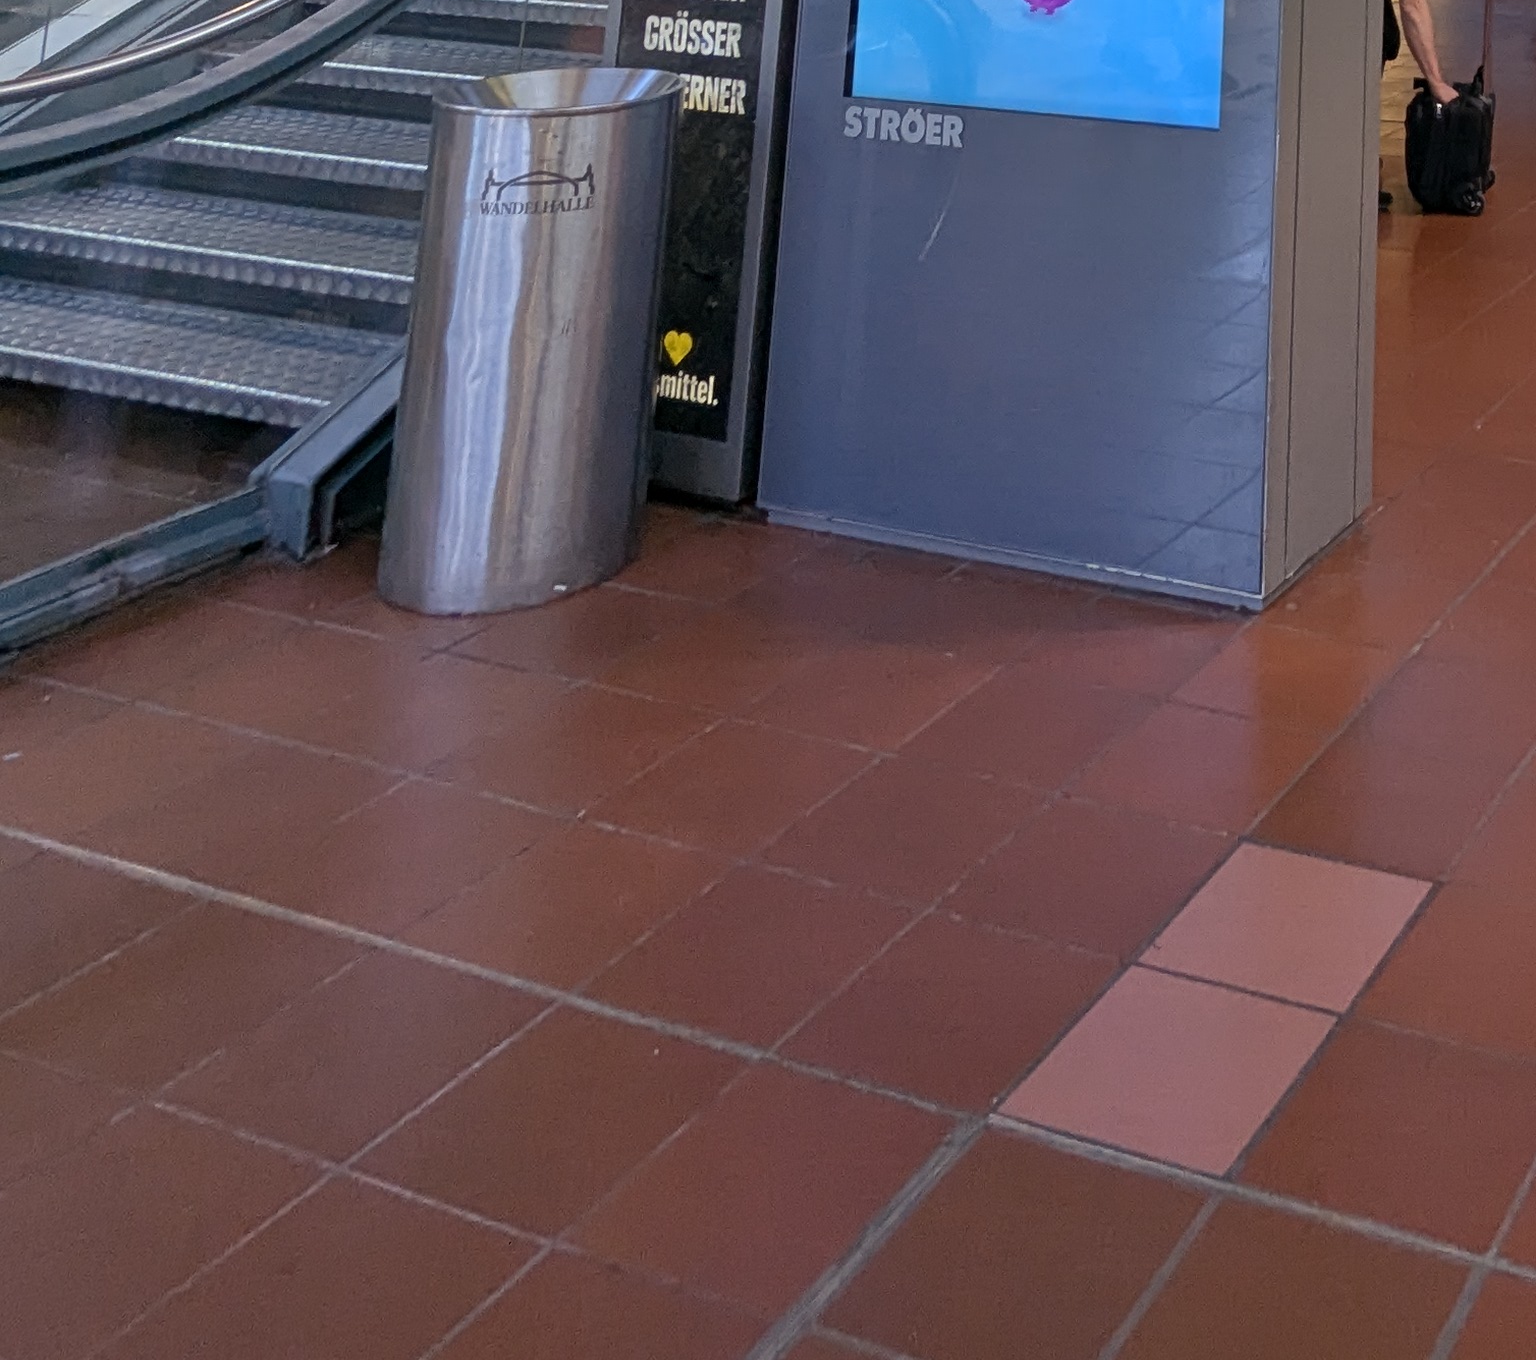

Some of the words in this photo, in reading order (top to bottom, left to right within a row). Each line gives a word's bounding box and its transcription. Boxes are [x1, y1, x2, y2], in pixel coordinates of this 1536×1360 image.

[643, 10, 742, 59] GRÖSSER
[678, 73, 747, 115] ERNER
[843, 105, 964, 148] STRÖER
[480, 196, 595, 216] WANDELHALLE
